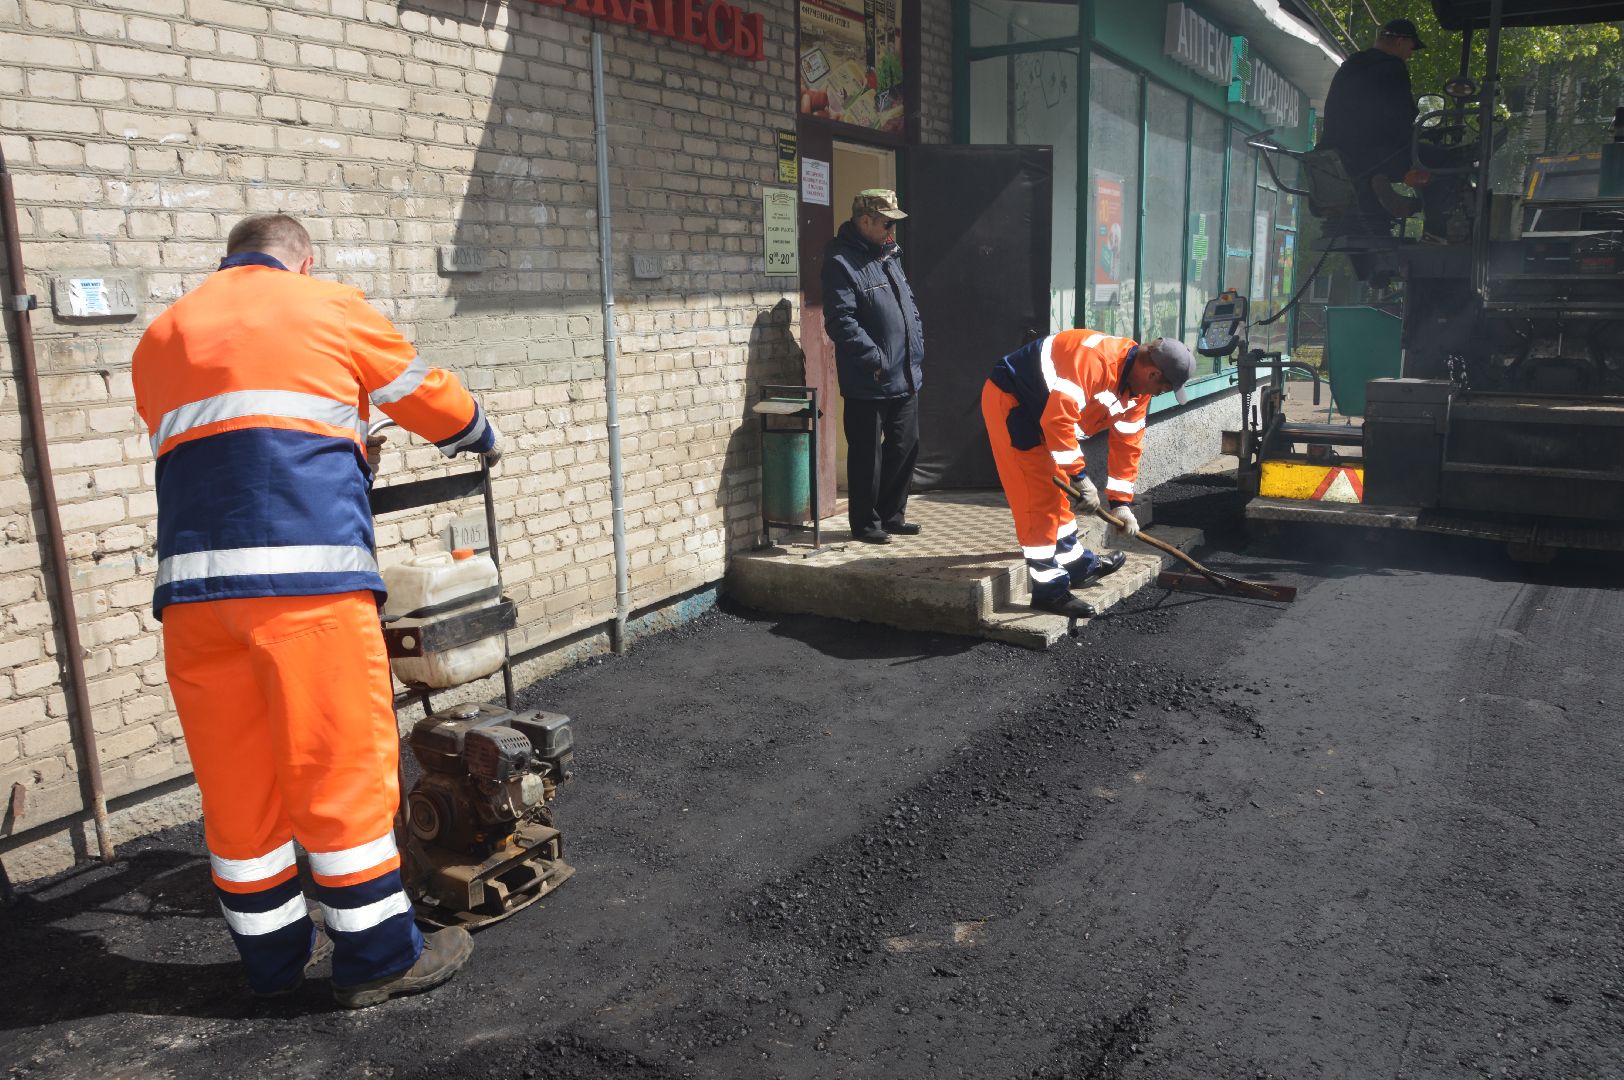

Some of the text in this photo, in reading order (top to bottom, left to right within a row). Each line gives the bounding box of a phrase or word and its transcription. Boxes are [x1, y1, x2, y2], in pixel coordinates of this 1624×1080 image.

[550, 0, 765, 61] АТЕСЫ
[1177, 2, 1233, 85] АПТЕКИ
[1253, 57, 1299, 127] ГОРЗДРАВ
